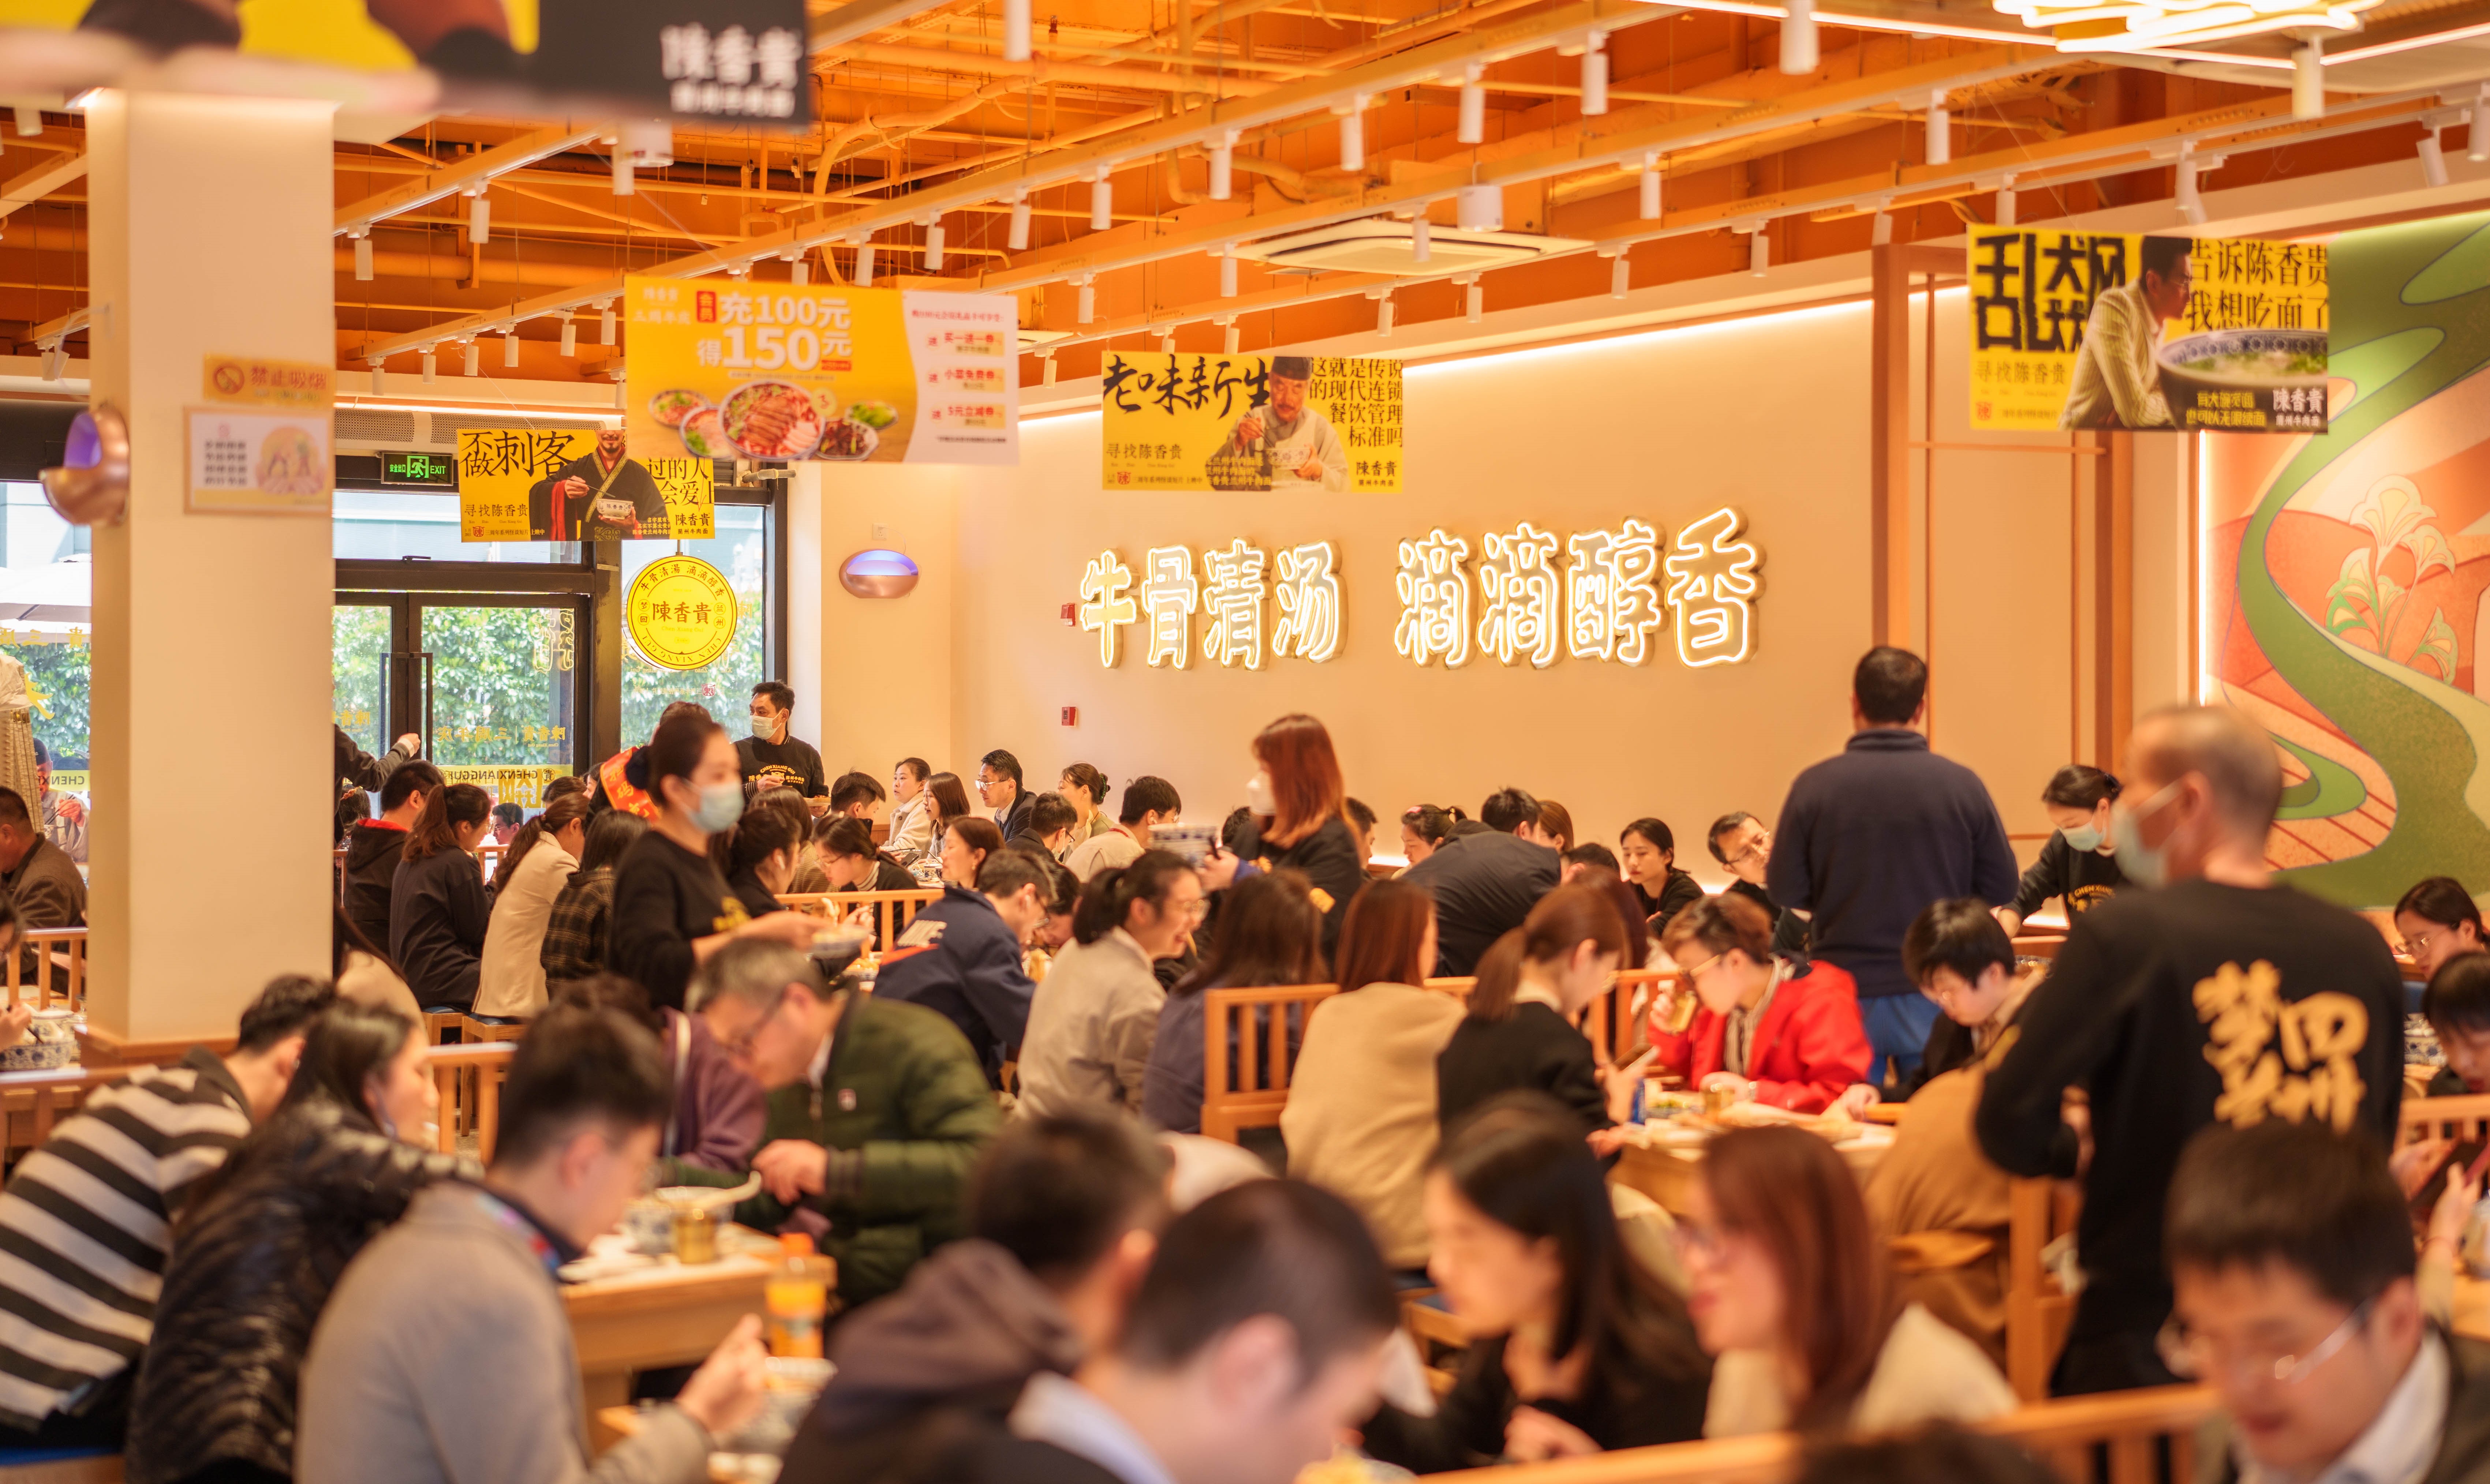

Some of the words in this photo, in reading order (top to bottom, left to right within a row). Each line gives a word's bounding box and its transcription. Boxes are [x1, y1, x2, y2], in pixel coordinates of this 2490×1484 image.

[718, 292, 852, 329] 充100元
[697, 327, 852, 371] 得150元
[251, 365, 327, 390] 禁止吸烟
[1312, 357, 1402, 379] 这就是传说
[1310, 379, 1402, 401] 的现代连锁
[2273, 387, 2323, 413] 陳香貴
[1331, 402, 1402, 425] 餐饮管理
[1349, 426, 1402, 447] 标准吗
[1107, 443, 1182, 460] 寻找陈香贵
[390, 464, 406, 473] 安全出口
[430, 465, 446, 475] EXIT
[647, 457, 709, 480] 过的人
[1356, 461, 1396, 476] 陳香貴
[465, 504, 528, 517] 寻找陈香贵
[676, 513, 710, 526] 陳香貴
[1080, 536, 1348, 671] 牛骨清汤
[1394, 503, 1767, 671] 滴滴醇香
[653, 601, 711, 624] 陳香貴
